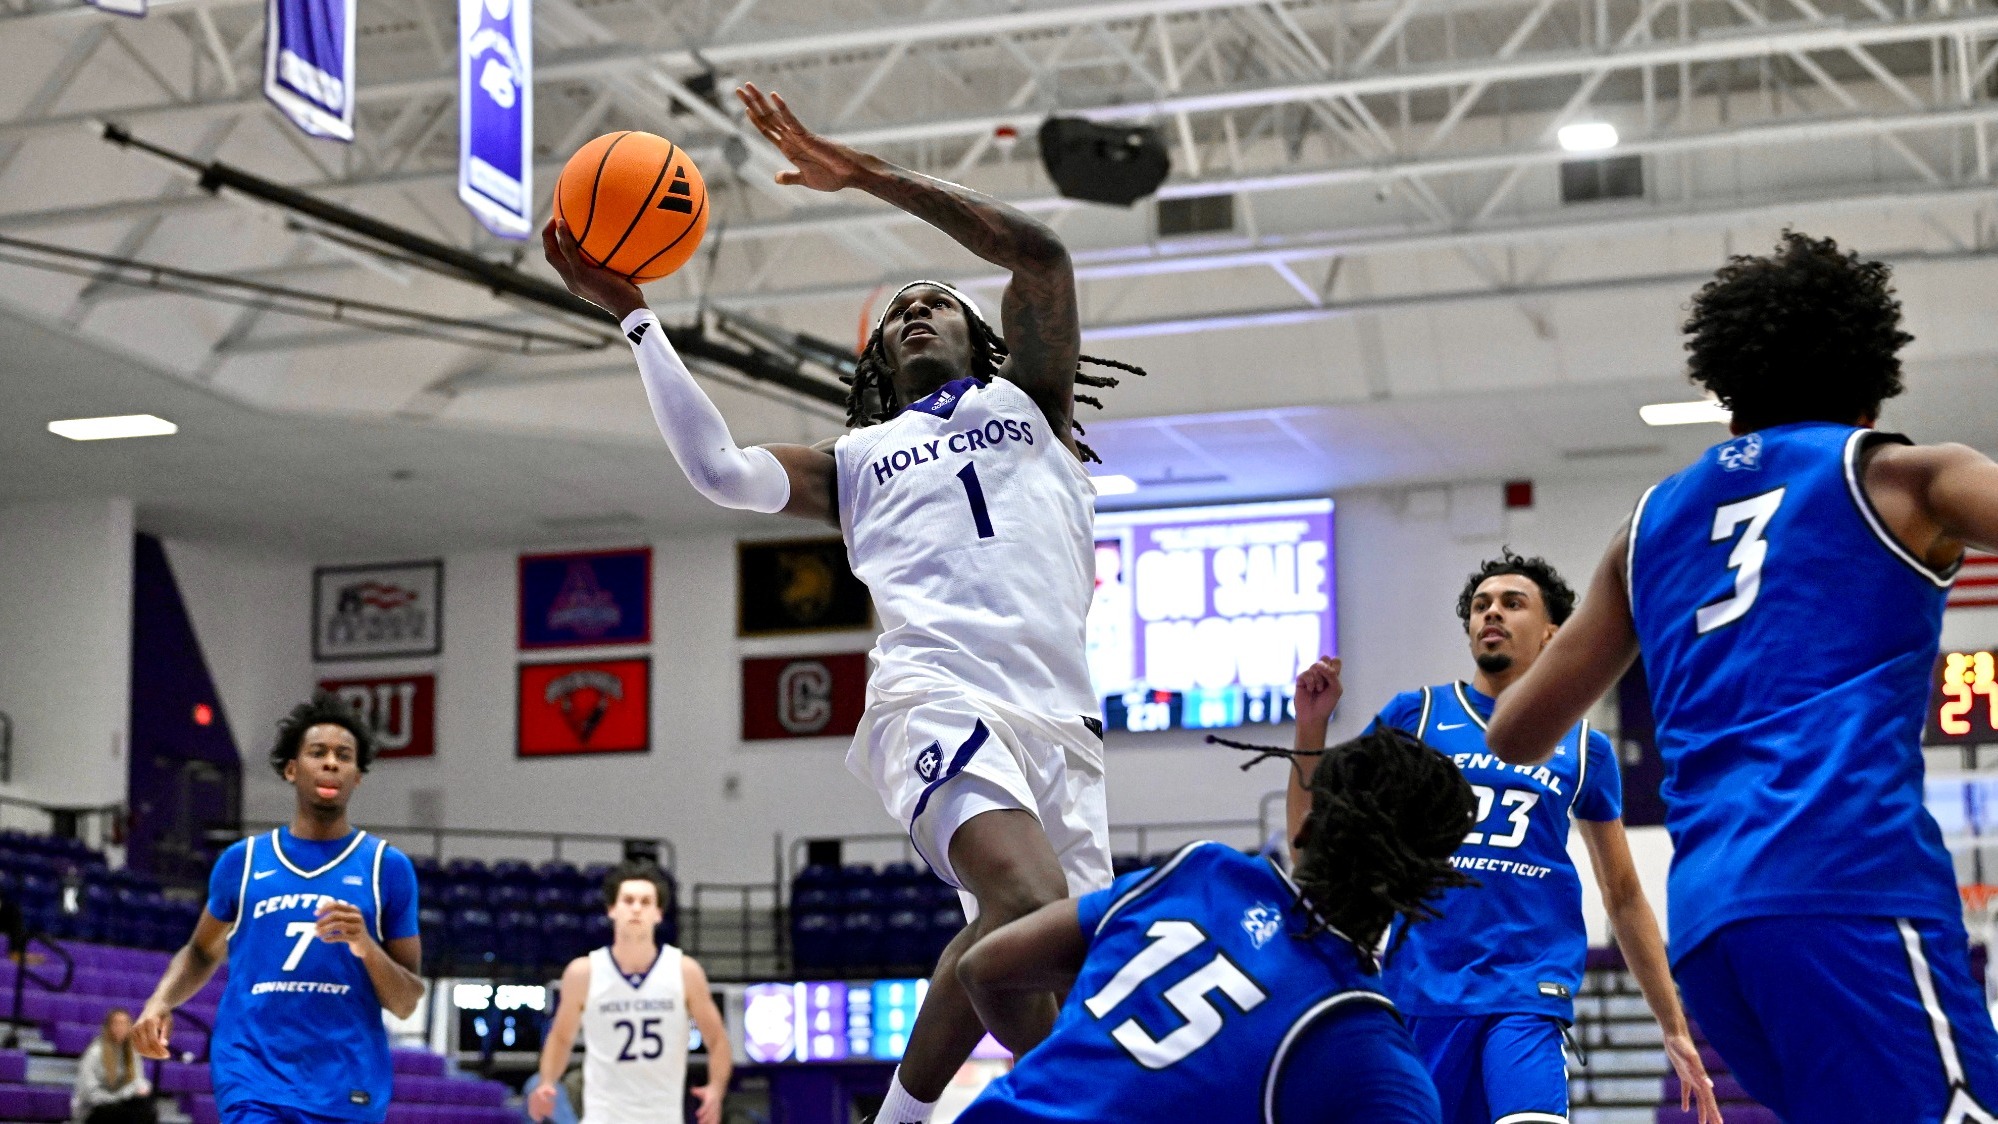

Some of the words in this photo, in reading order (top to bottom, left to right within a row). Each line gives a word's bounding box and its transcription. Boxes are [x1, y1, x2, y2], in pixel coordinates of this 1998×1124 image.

[931, 395, 956, 411] adidas
[873, 440, 940, 485] HOLY
[948, 419, 1034, 454] CROSS
[956, 461, 995, 539] 1
[1136, 551, 1206, 621] ON
[1213, 541, 1328, 618] SALE
[1696, 486, 1786, 635] 3
[778, 661, 832, 734] C
[1449, 856, 1551, 879] NNECTICUT
[282, 921, 319, 971] 7
[251, 981, 351, 996] CONNECTICUT
[1084, 920, 1267, 1069] 15
[613, 1017, 664, 1061] 25
